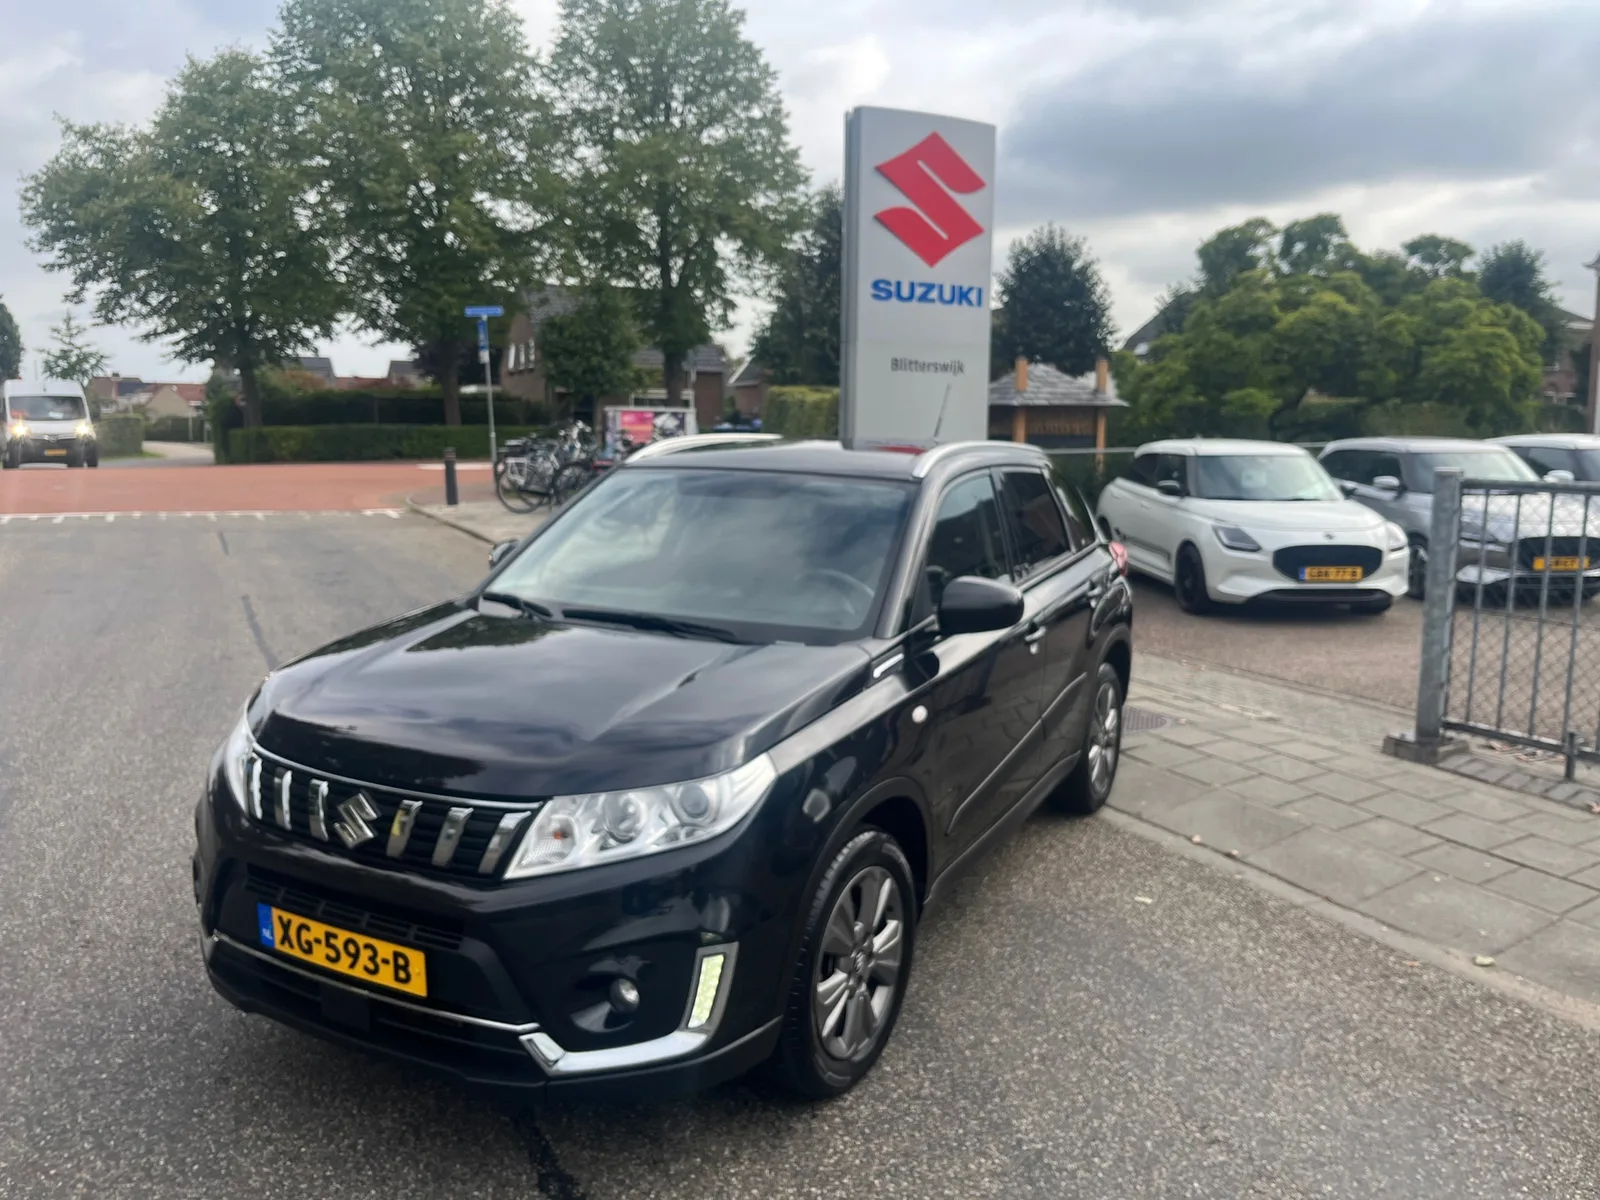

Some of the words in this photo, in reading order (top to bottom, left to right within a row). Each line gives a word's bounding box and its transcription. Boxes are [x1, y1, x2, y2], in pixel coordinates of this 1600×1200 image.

[871, 279, 983, 308] SUZUKI
[890, 357, 965, 376] Blitterswijk
[277, 914, 412, 985] XG-593-B
